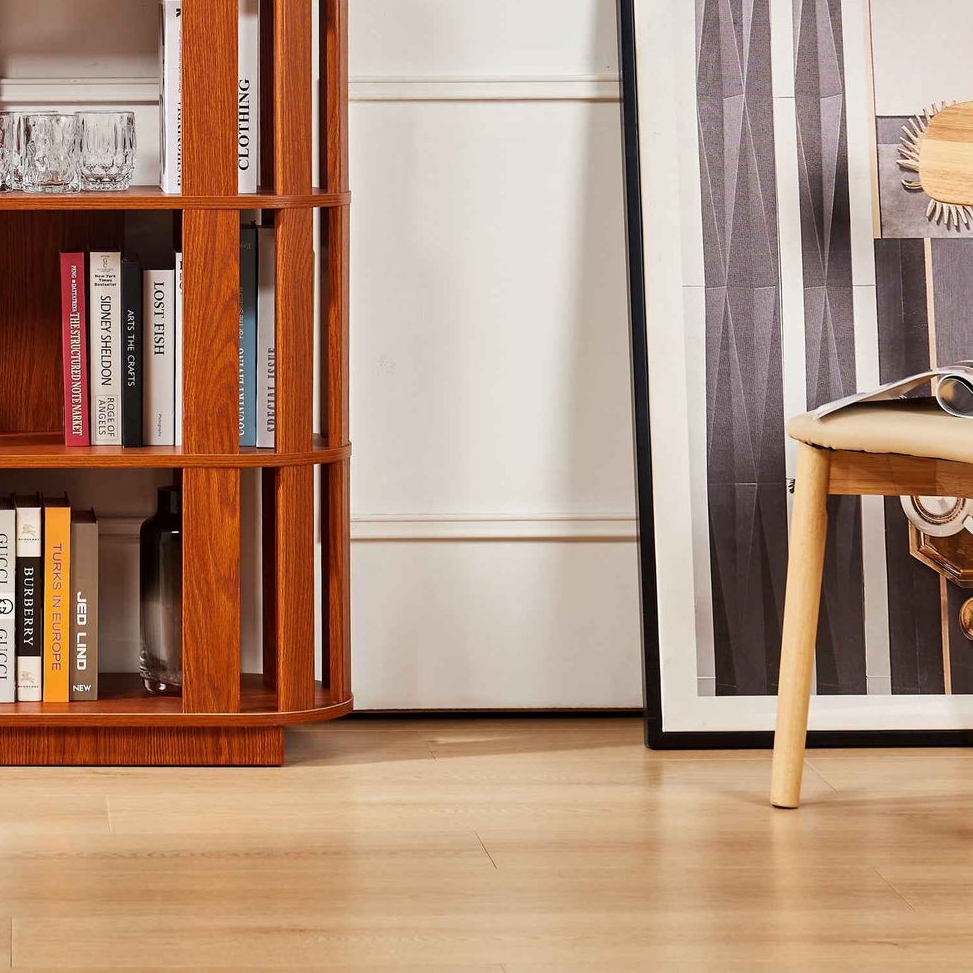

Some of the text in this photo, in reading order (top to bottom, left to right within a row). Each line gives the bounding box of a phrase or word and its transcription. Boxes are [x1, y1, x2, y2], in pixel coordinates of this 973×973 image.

[238, 78, 250, 171] CLOTHING
[69, 313, 80, 329] THE
[70, 330, 81, 381] STRUCTURED
[100, 295, 112, 386] SIDNEY SHELDON
[127, 309, 135, 387] ARTS THE CRAFTS
[153, 281, 165, 356] LOST FISH
[71, 381, 82, 404] NOTE
[98, 399, 106, 435] ANGELS
[107, 425, 115, 437] OF
[23, 567, 34, 647] BURBERRY
[51, 543, 62, 671] TURKS IN EUROPE
[76, 591, 87, 670] JED LIND
[72, 684, 92, 692] NEW
